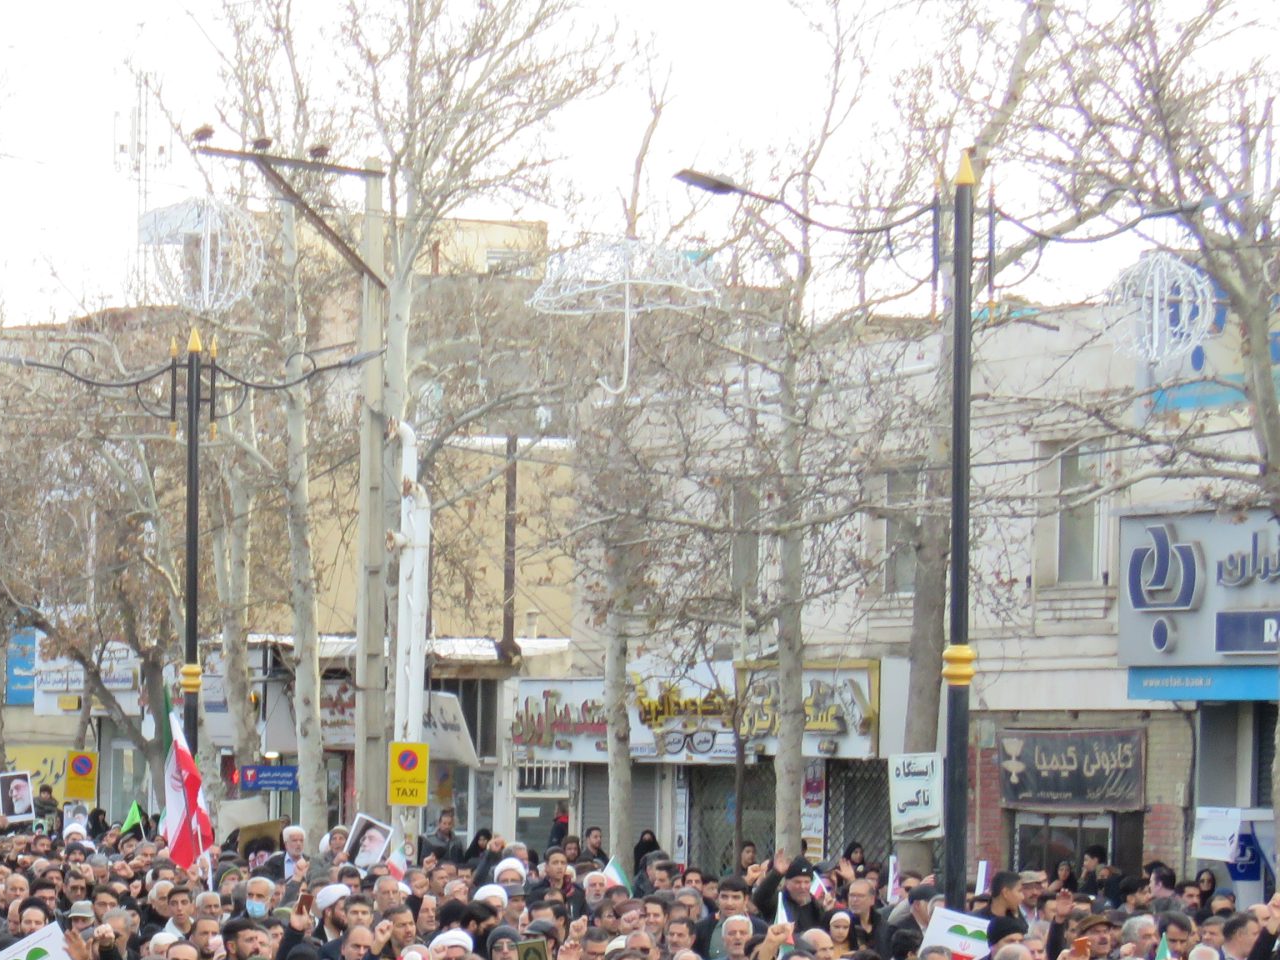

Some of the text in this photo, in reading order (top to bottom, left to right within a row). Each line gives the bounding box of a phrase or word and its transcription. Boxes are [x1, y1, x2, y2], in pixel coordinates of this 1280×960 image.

[895, 760, 935, 781] ایستگاه
[1035, 746, 1078, 777] کیمیا
[396, 787, 418, 798] TAXI
[897, 789, 930, 813] تاکسی
